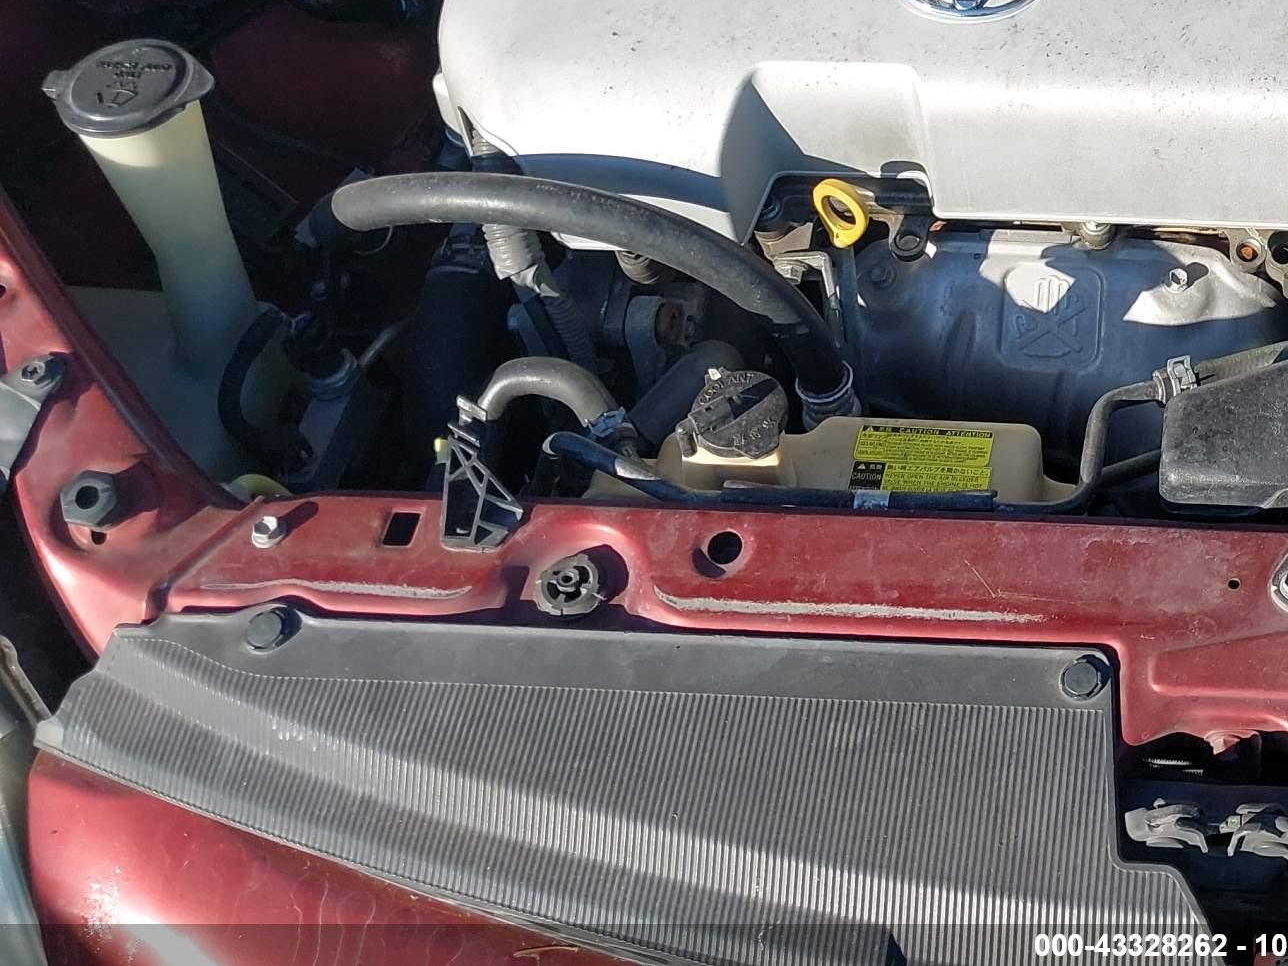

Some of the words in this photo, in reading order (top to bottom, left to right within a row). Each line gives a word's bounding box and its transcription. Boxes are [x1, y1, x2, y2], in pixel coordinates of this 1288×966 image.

[899, 427, 940, 435] CAUTION
[945, 430, 991, 439] ATTENTION
[851, 472, 882, 481] CAUTION
